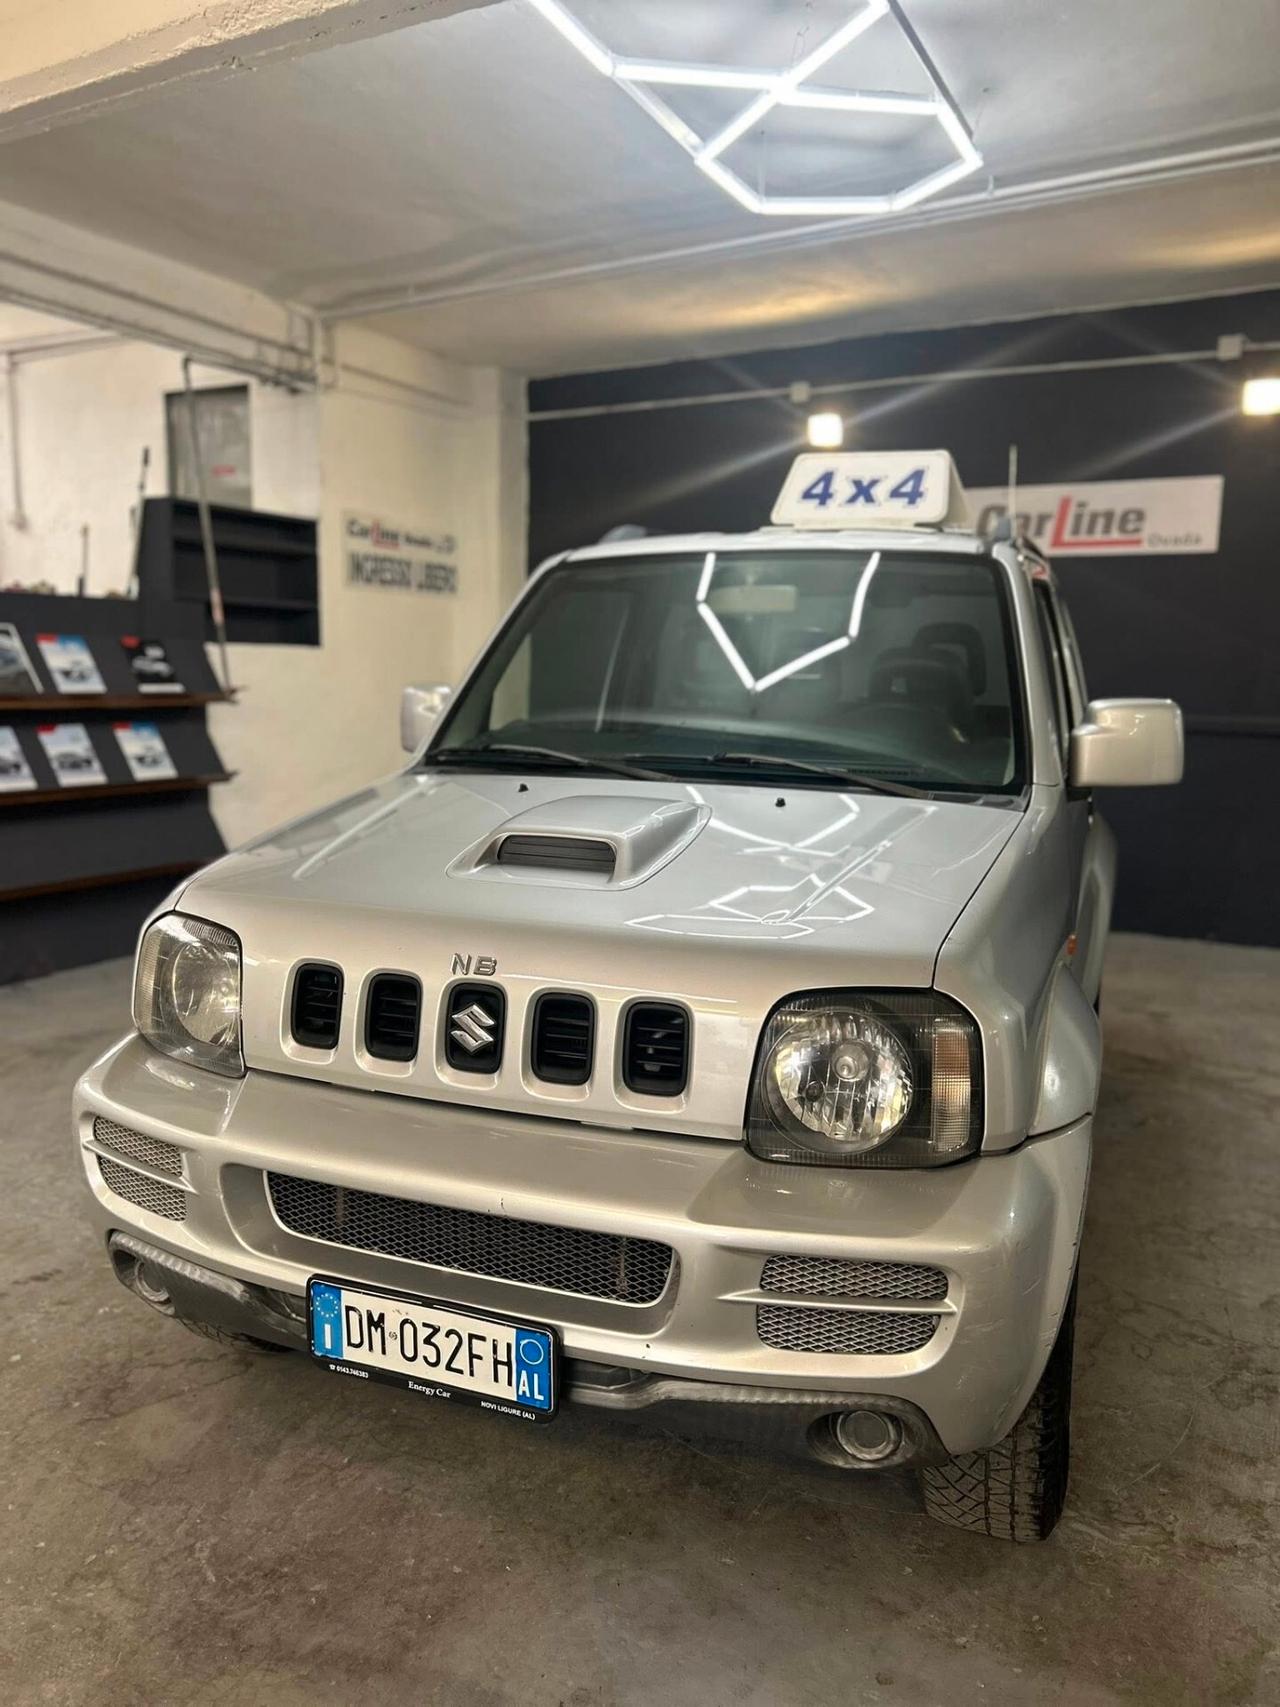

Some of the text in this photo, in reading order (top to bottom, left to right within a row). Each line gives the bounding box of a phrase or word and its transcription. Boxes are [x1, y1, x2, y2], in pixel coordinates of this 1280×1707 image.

[450, 953, 498, 976] NB
[408, 1381, 451, 1398] Energy Car
[518, 1370, 544, 1400] AL
[480, 1400, 497, 1410] NOVI
[497, 1405, 521, 1417] LIGURE
